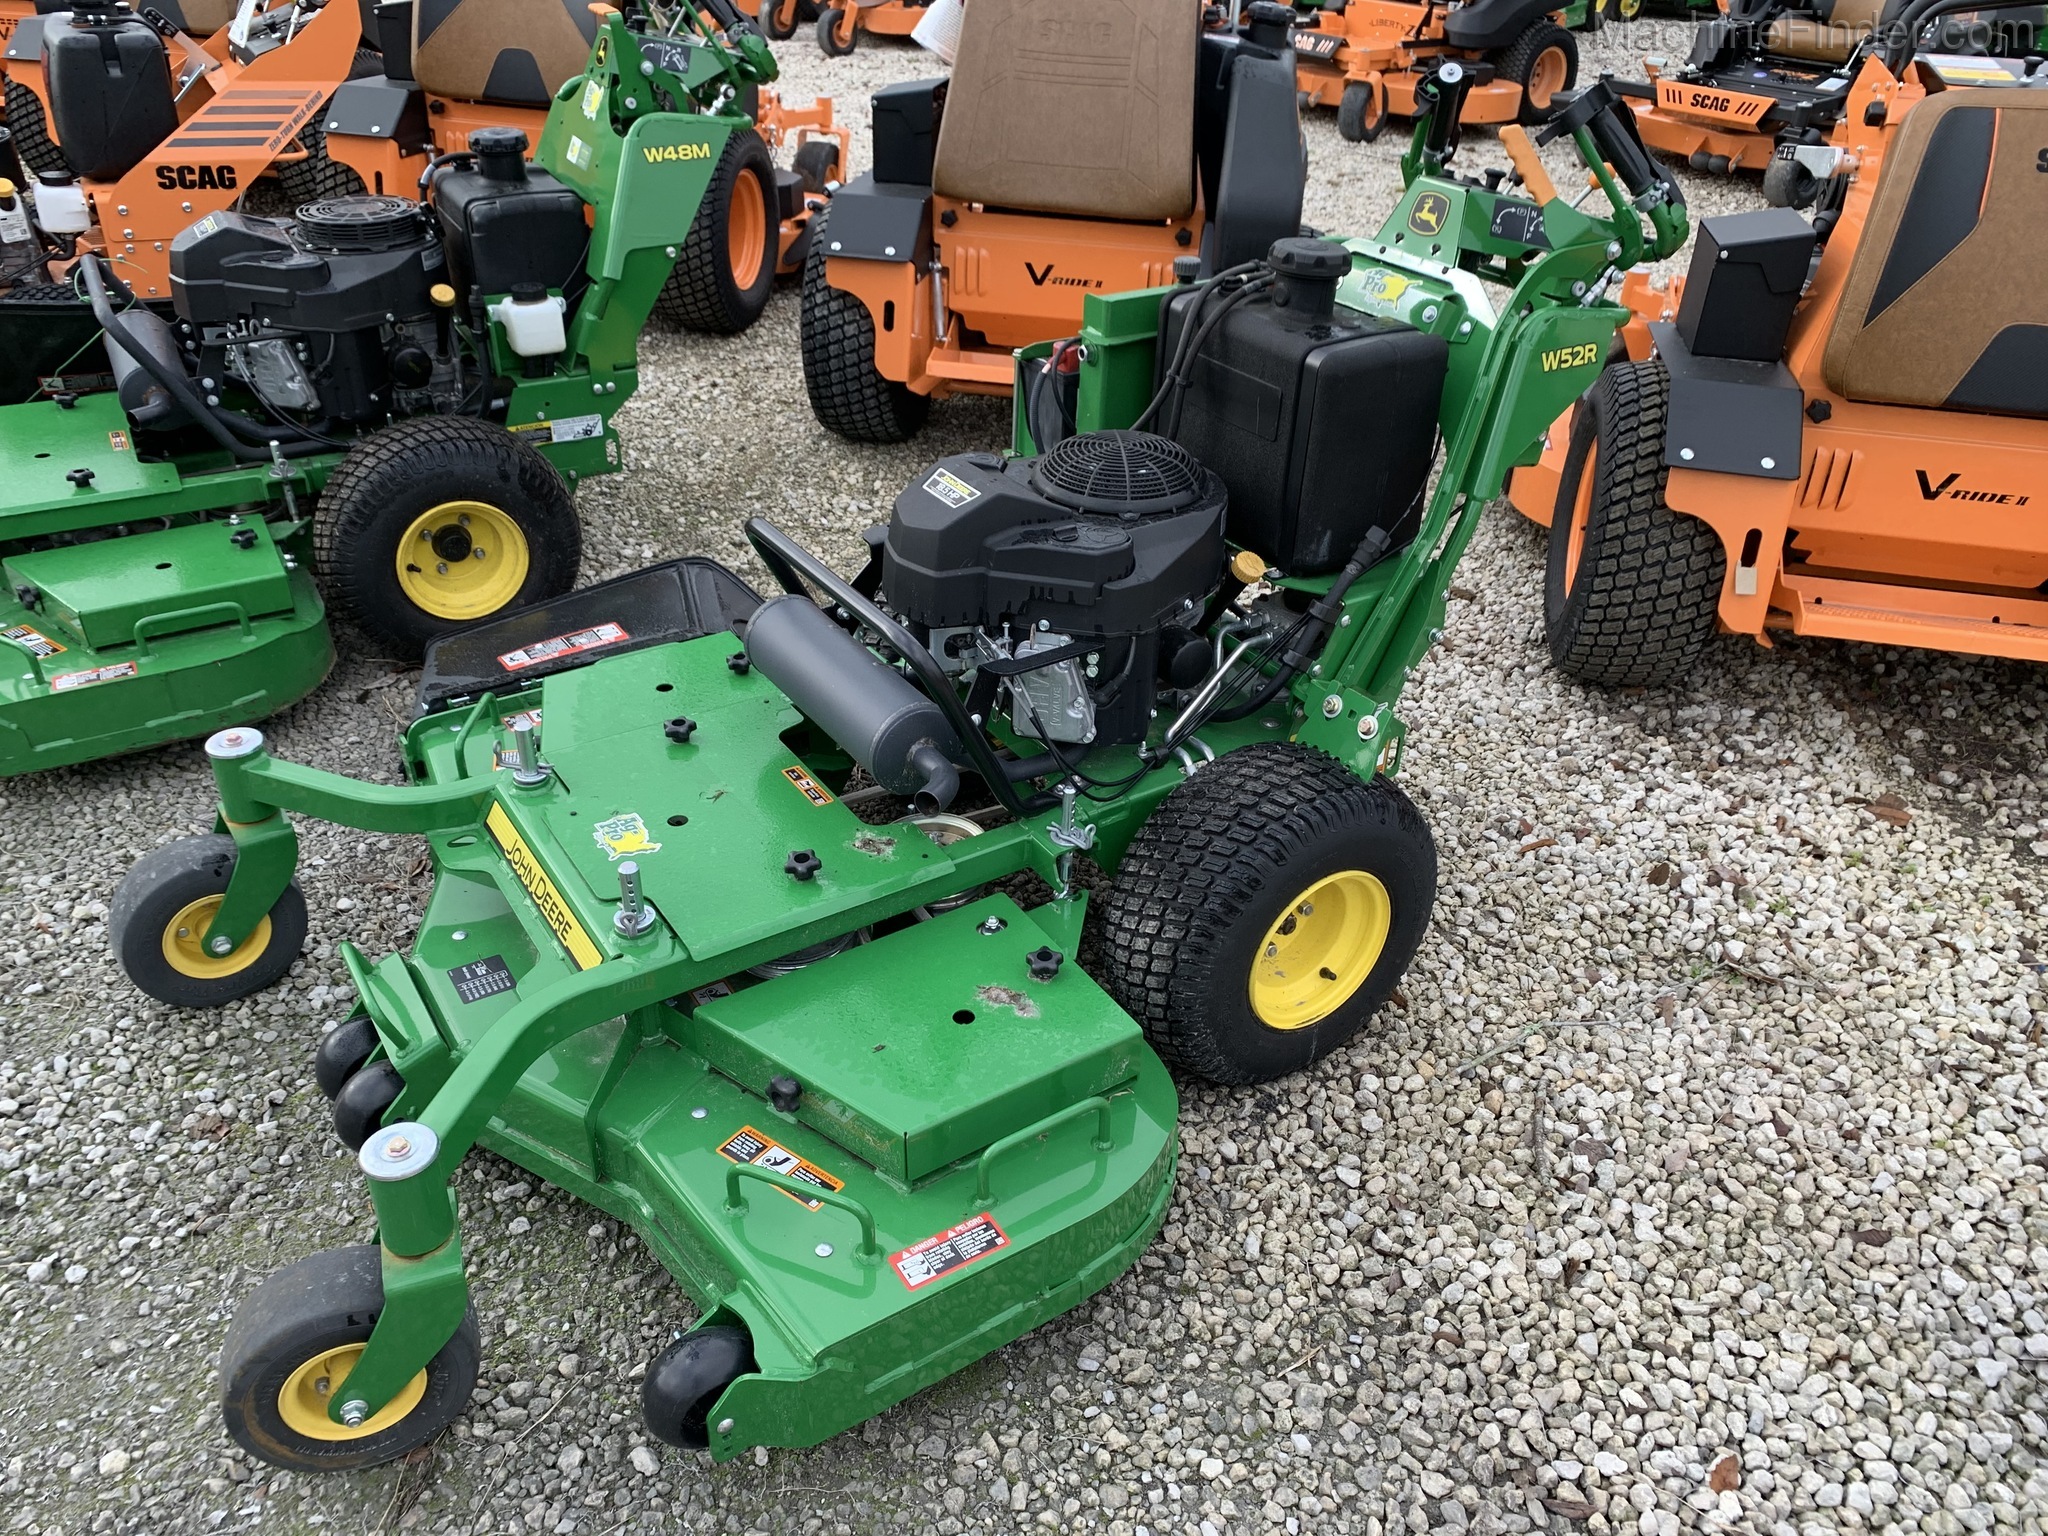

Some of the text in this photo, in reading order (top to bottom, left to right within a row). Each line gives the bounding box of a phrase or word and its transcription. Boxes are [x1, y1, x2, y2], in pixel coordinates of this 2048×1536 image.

[292, 90, 323, 126] WALK-BEHIND
[1690, 93, 1730, 112] SCAG
[643, 142, 711, 164] W48M
[155, 165, 237, 190] SCAG
[1024, 262, 1093, 288] V-RIDE
[1362, 276, 1387, 293] Pro
[1541, 343, 1598, 373] W52R
[935, 483, 950, 494] 18.5
[947, 489, 960, 499] HP
[1915, 469, 2014, 505] V-RIDE
[600, 821, 623, 841] Pro
[505, 838, 572, 942] JOHN DEERE
[954, 1216, 984, 1234] PELIGRO
[909, 1237, 939, 1254] DANGER
